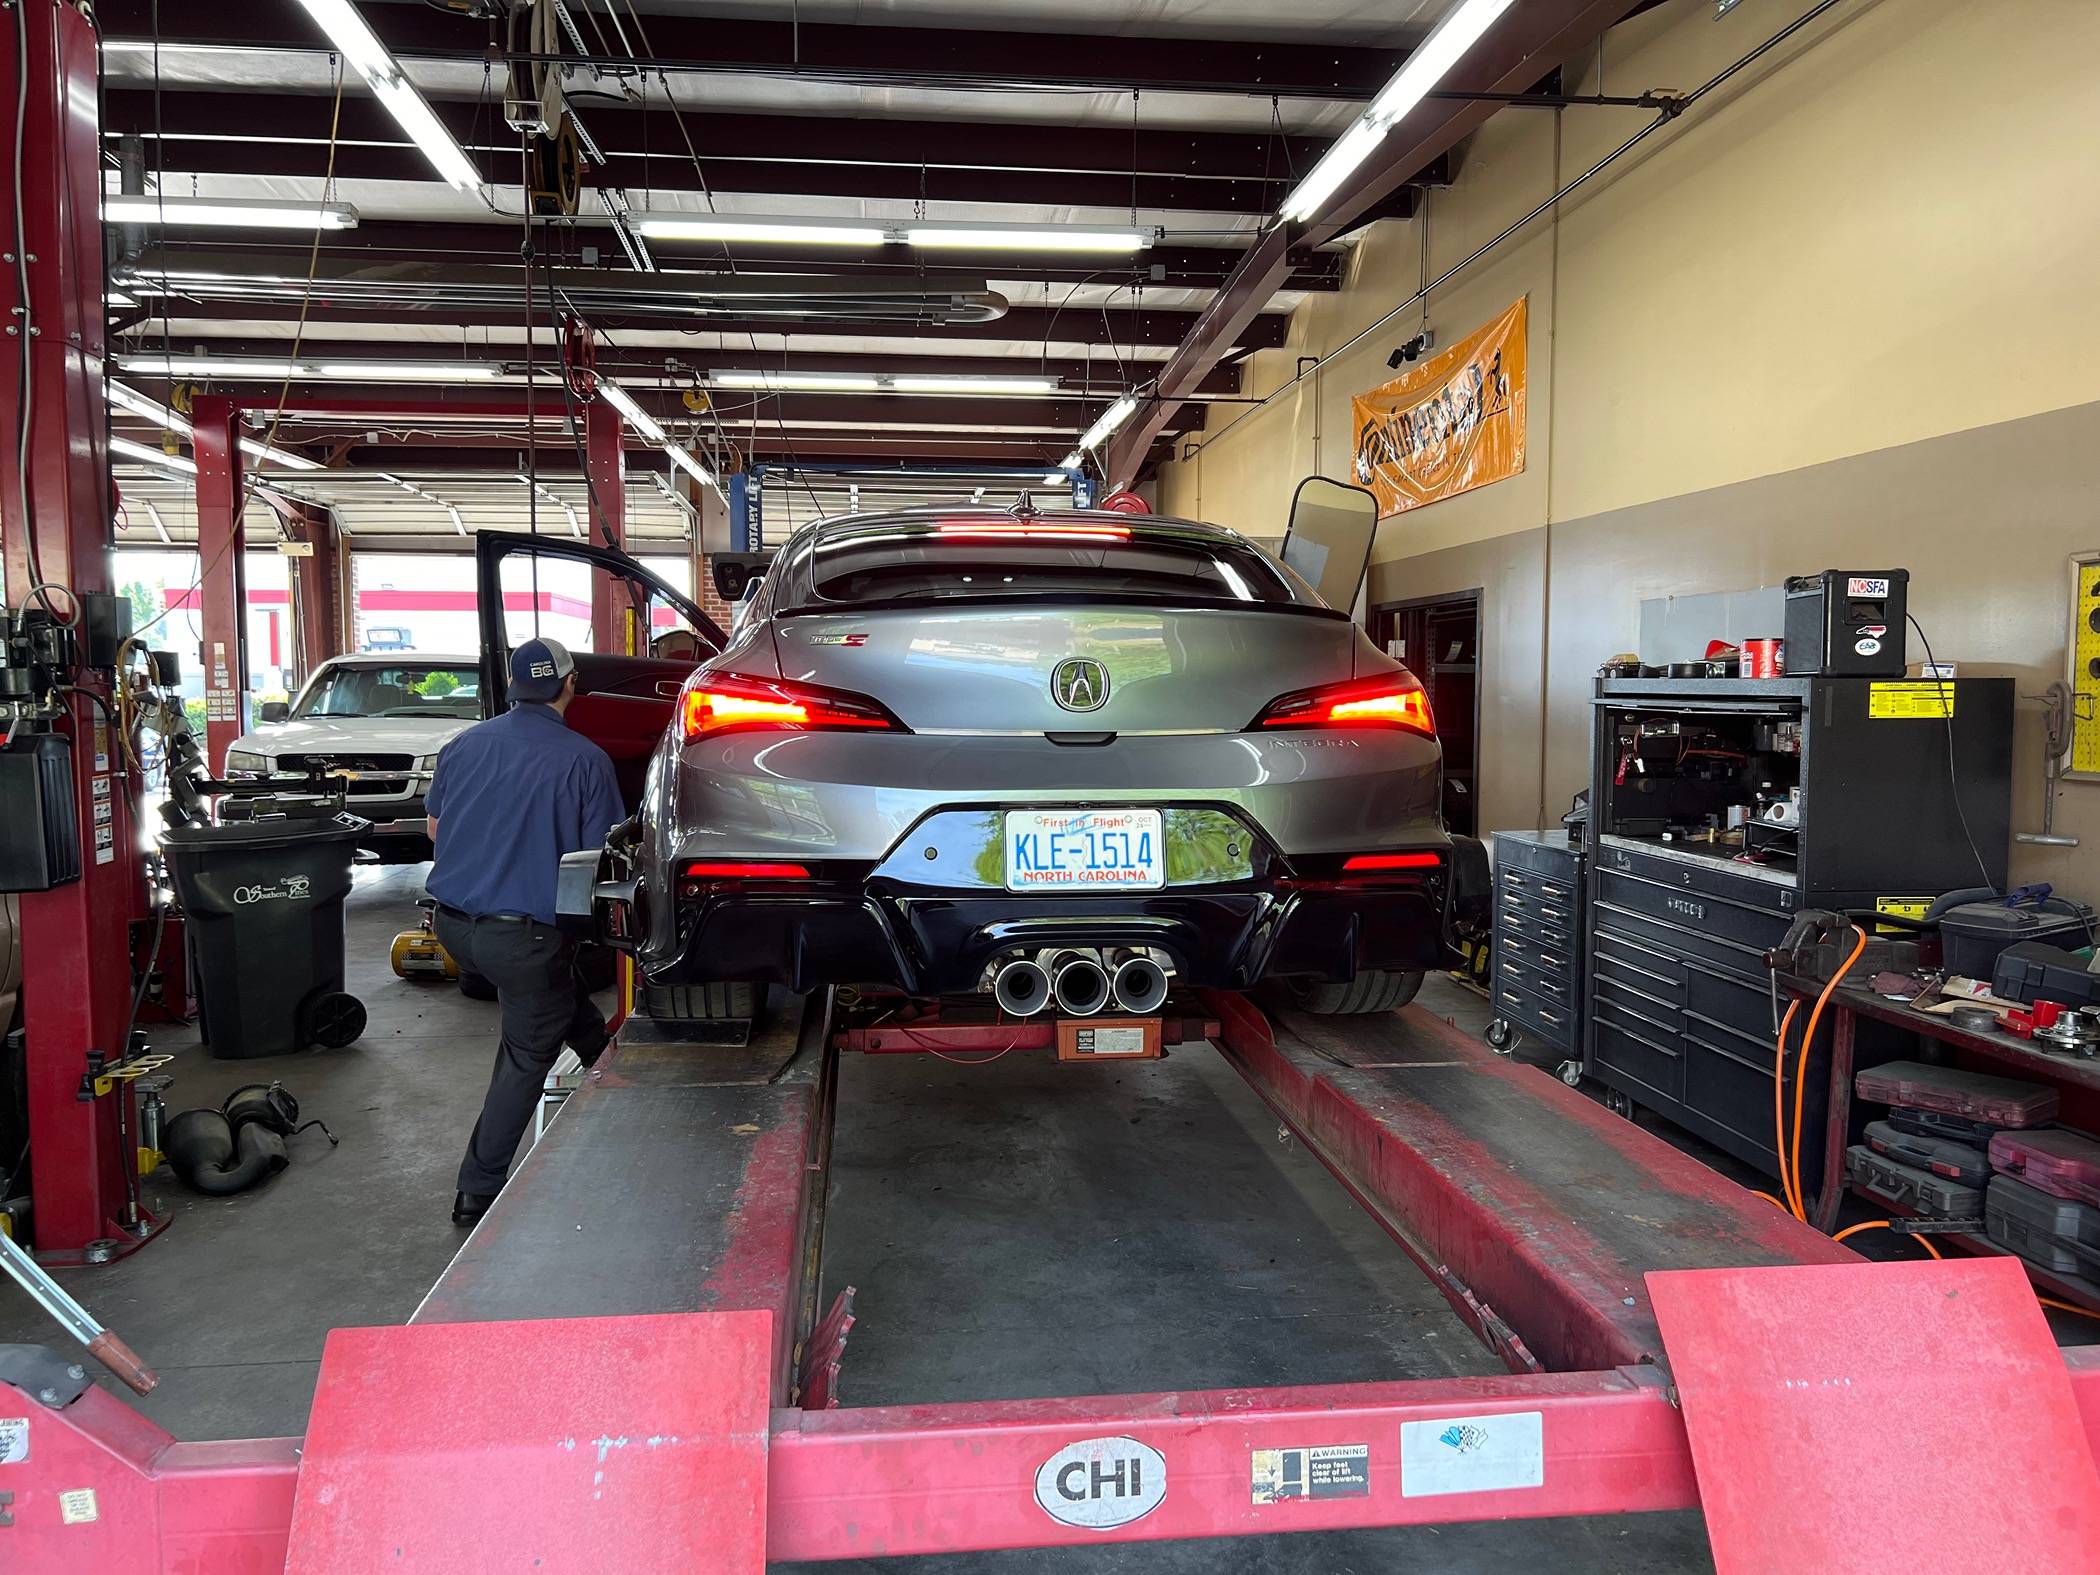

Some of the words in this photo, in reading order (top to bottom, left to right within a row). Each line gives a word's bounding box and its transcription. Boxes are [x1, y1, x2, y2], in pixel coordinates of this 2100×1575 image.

[748, 475, 758, 502] LIFT
[748, 504, 759, 553] ROTARY
[531, 665, 554, 678] BG
[1043, 818, 1068, 827] First
[1093, 817, 1125, 829] Flight
[1015, 832, 1152, 870] KLE-1514
[1023, 871, 1073, 882] NORTH
[1078, 870, 1147, 881] CAROLINA
[1321, 1447, 1366, 1457] WARNING
[1312, 1462, 1332, 1471] Keep
[1312, 1469, 1330, 1477] clear
[1056, 1458, 1141, 1501] CHI
[1312, 1476, 1332, 1484] while
